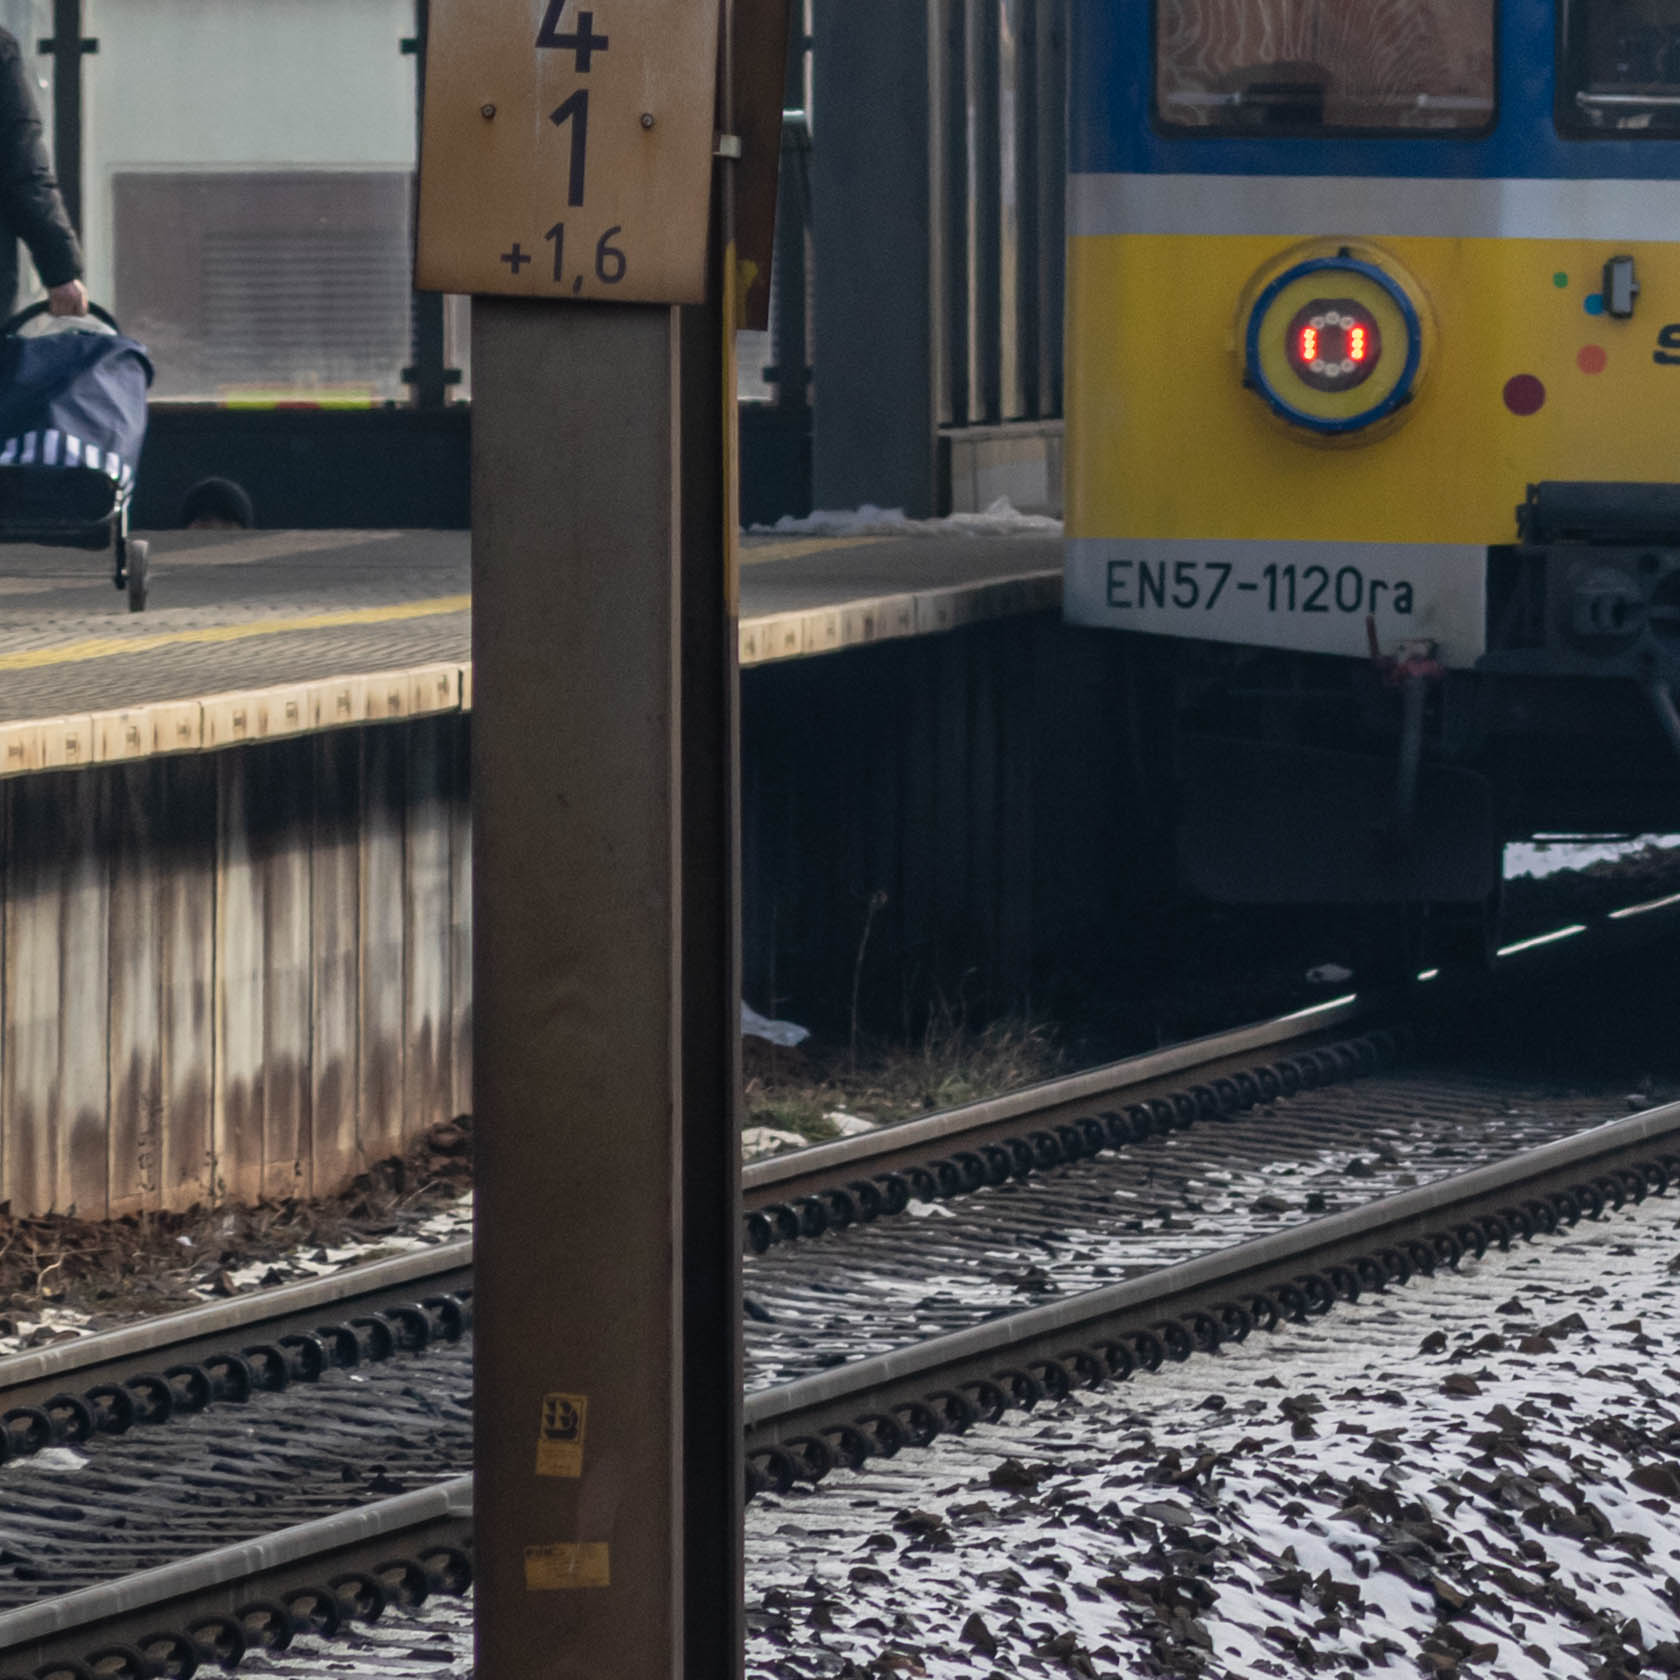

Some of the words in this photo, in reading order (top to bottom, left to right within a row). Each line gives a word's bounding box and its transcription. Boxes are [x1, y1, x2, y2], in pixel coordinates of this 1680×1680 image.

[549, 89, 589, 208] 1
[501, 222, 627, 295] +1,6
[1106, 560, 1414, 615] EN57-1120ra
